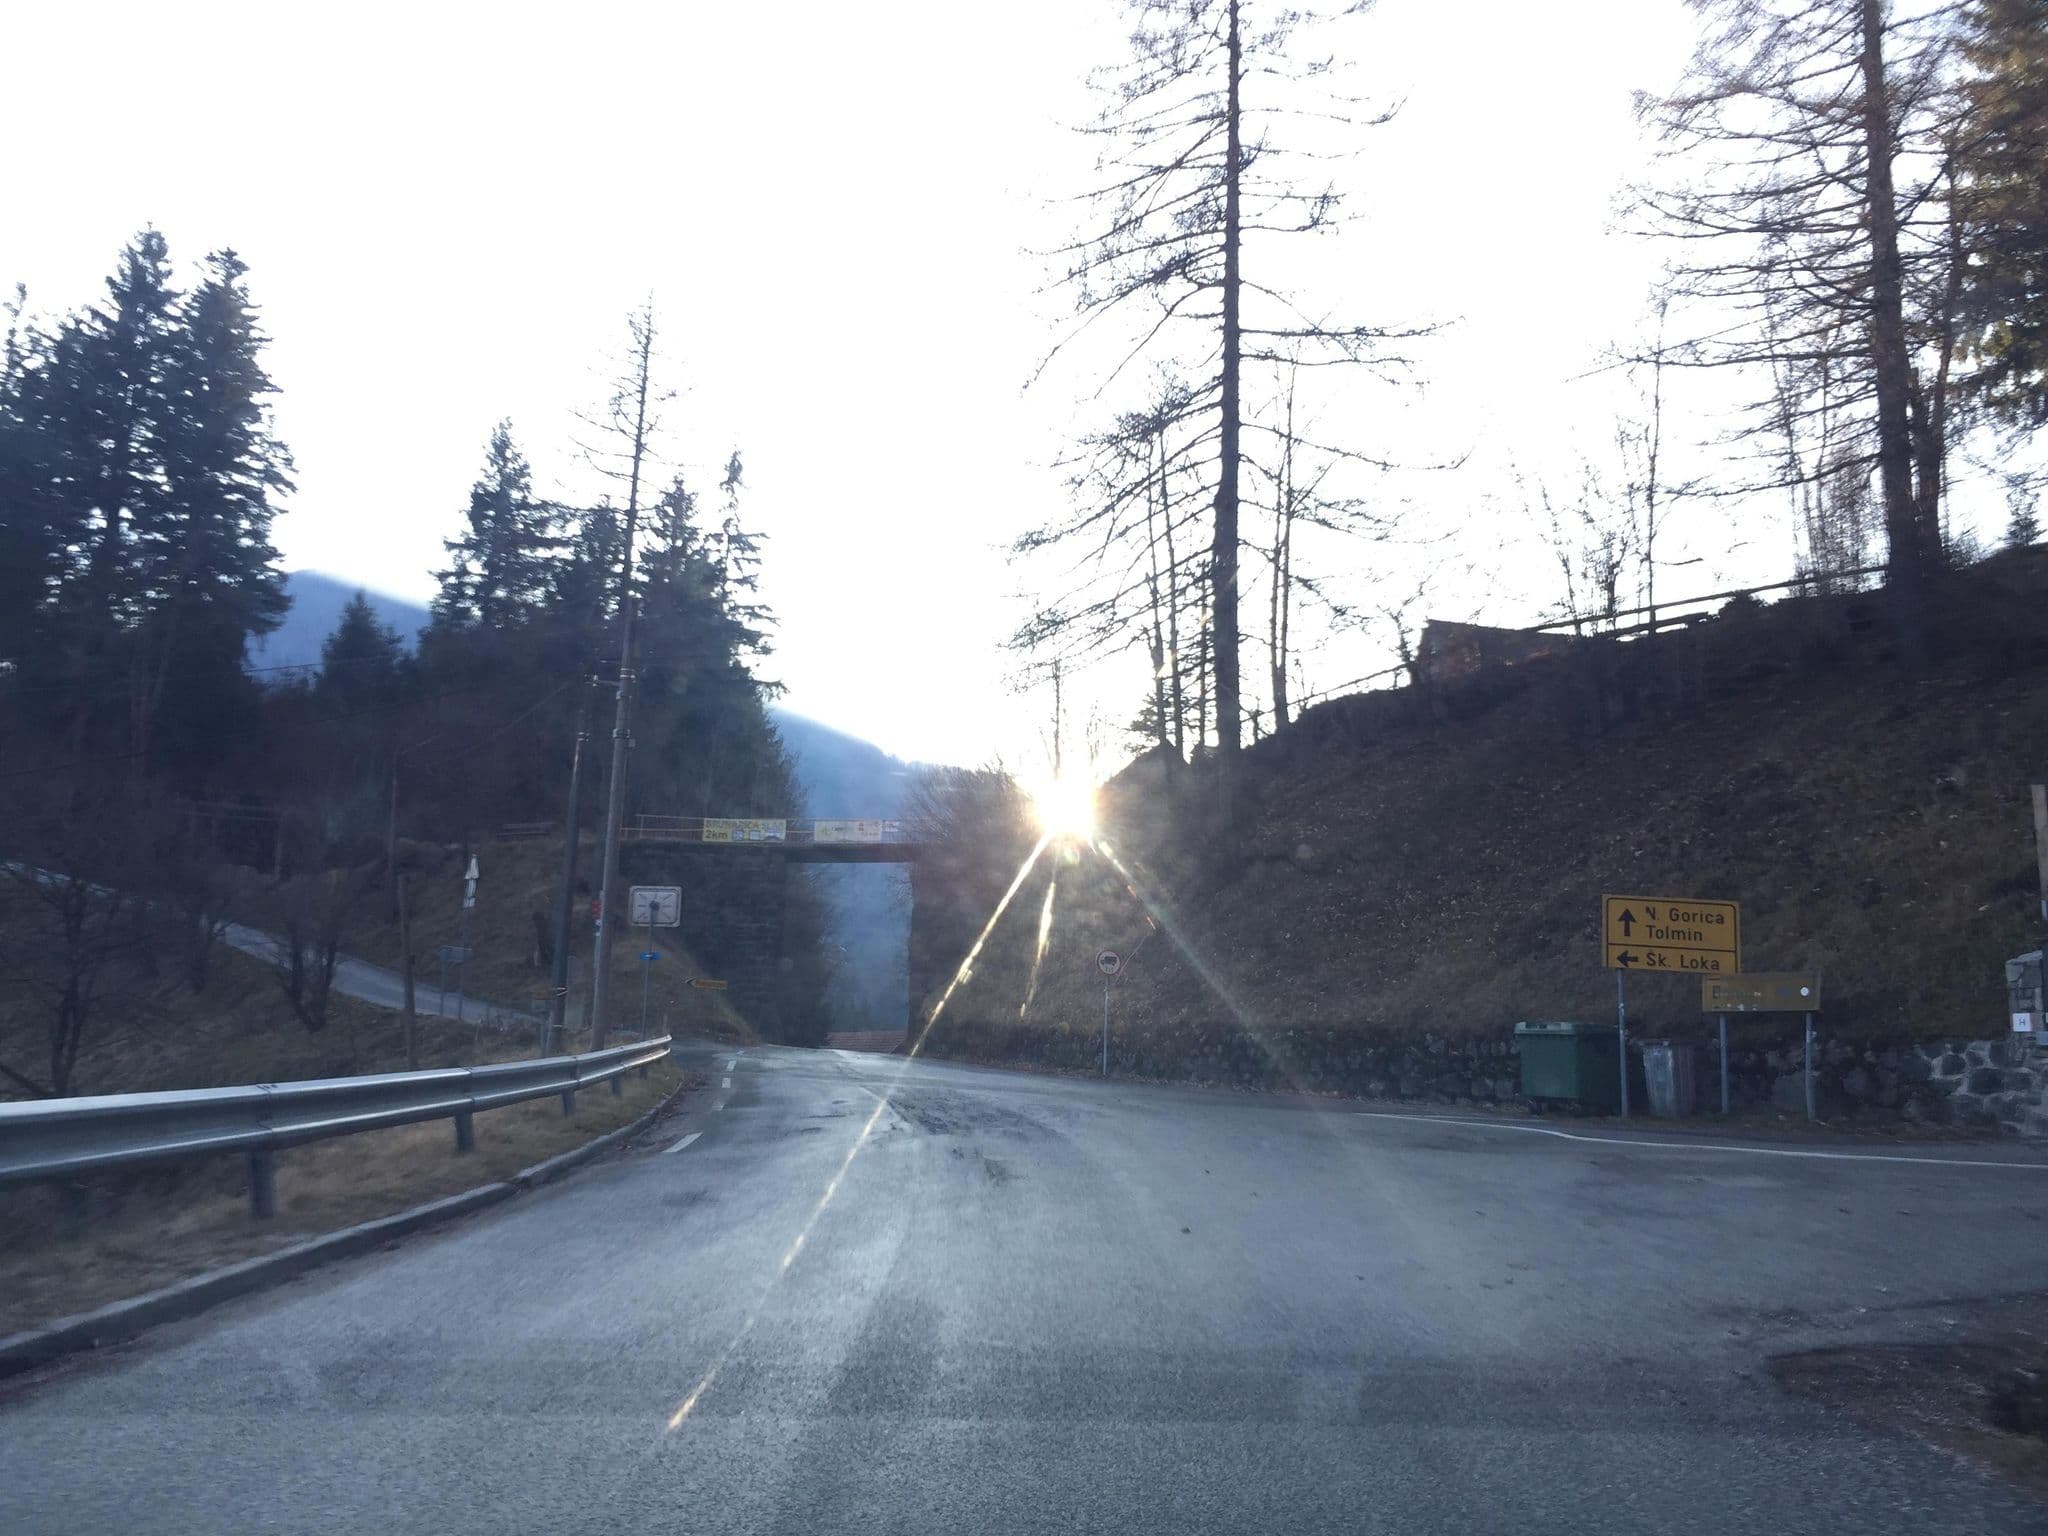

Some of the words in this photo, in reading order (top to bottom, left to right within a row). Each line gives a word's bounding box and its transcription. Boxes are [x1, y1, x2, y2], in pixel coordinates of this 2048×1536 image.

[1669, 908, 1725, 924] Gorica
[1646, 925, 1703, 940] Tolmin
[1680, 955, 1720, 969] Loka
